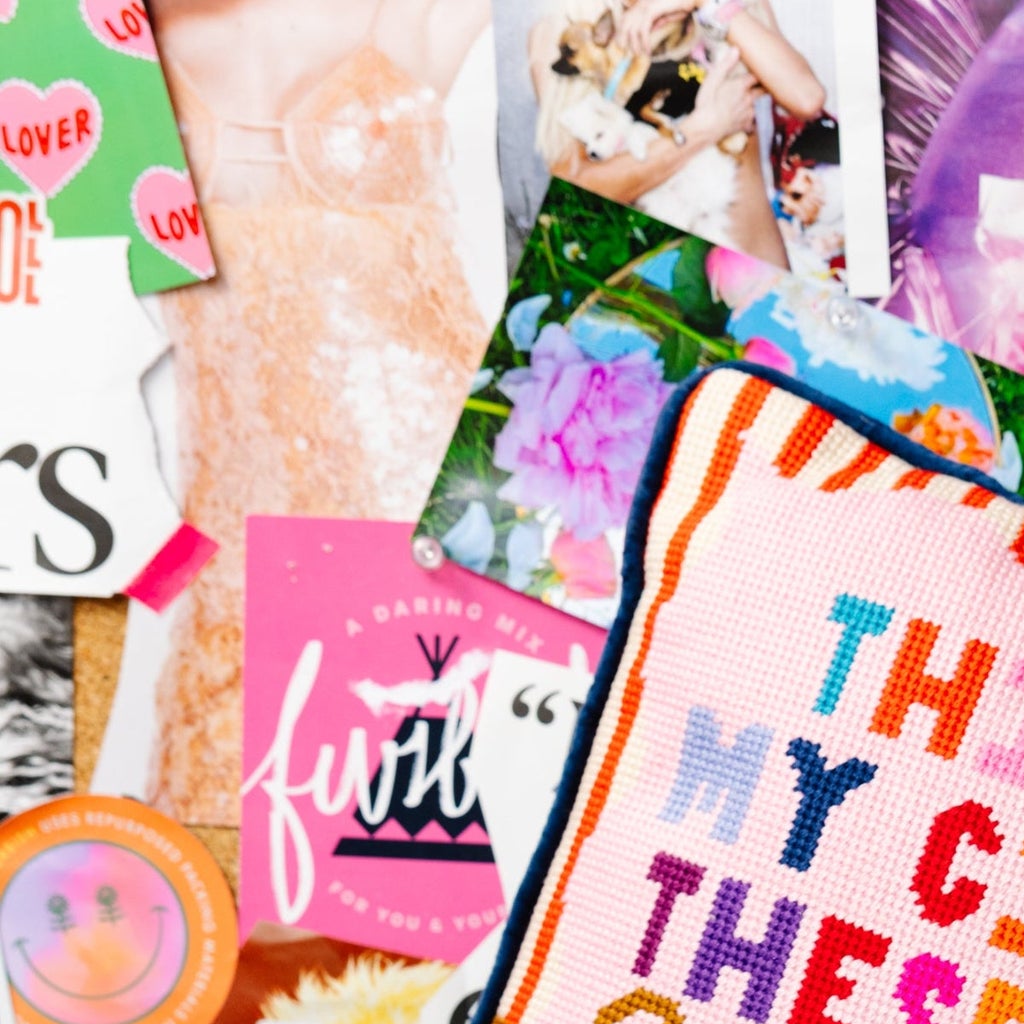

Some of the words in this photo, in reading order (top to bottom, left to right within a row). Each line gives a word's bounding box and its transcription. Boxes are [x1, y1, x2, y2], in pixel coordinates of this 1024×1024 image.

[1, 108, 91, 157] LOVER
[345, 617, 364, 638] A
[371, 597, 483, 624] DARING
[494, 612, 545, 654] MIX
[656, 704, 879, 872] MY
[328, 880, 370, 913] FOR
[377, 905, 422, 932] YOU
